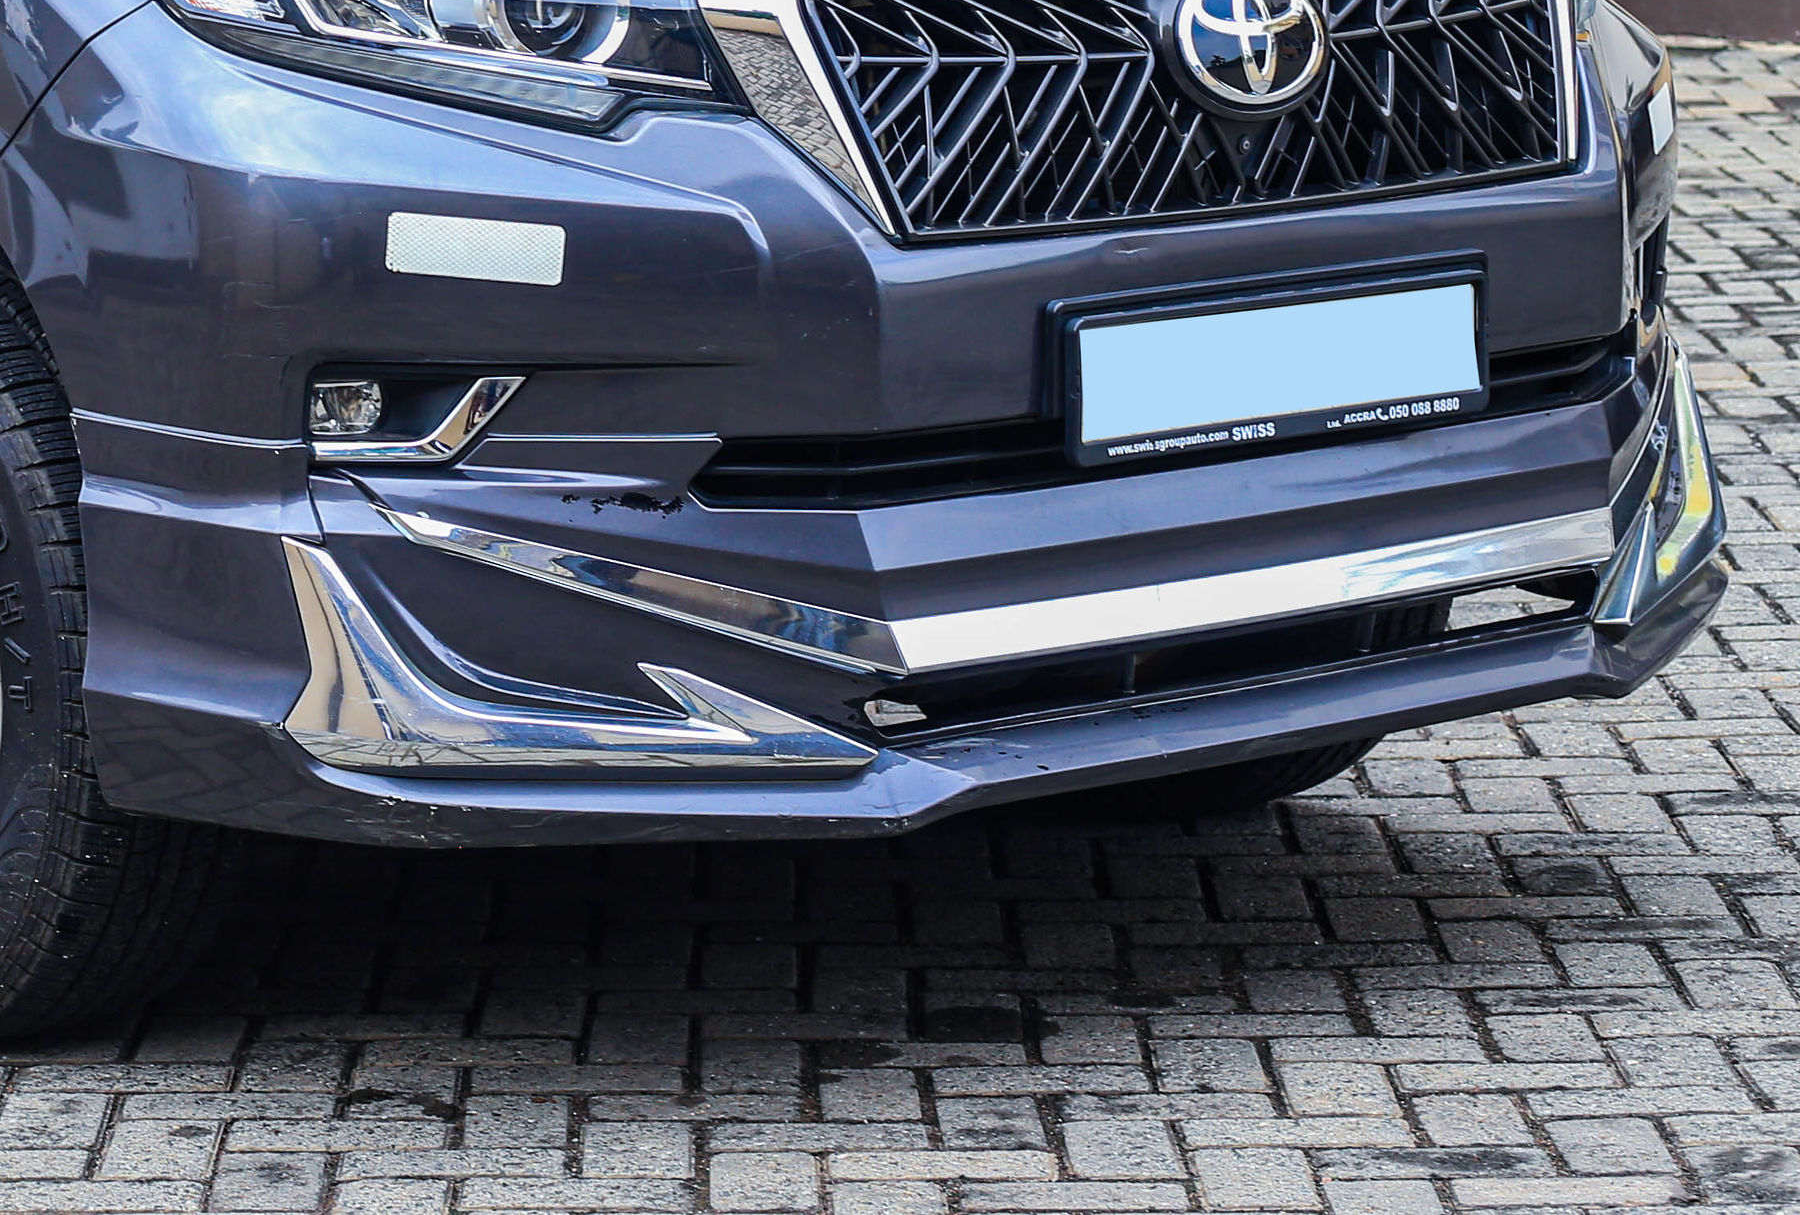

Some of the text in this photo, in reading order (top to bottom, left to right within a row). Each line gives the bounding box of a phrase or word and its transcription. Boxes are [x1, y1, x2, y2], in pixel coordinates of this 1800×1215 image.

[1343, 409, 1377, 425] ACCRA
[1389, 403, 1409, 420] 050
[1411, 400, 1431, 417] 088
[1433, 396, 1460, 413] 8880
